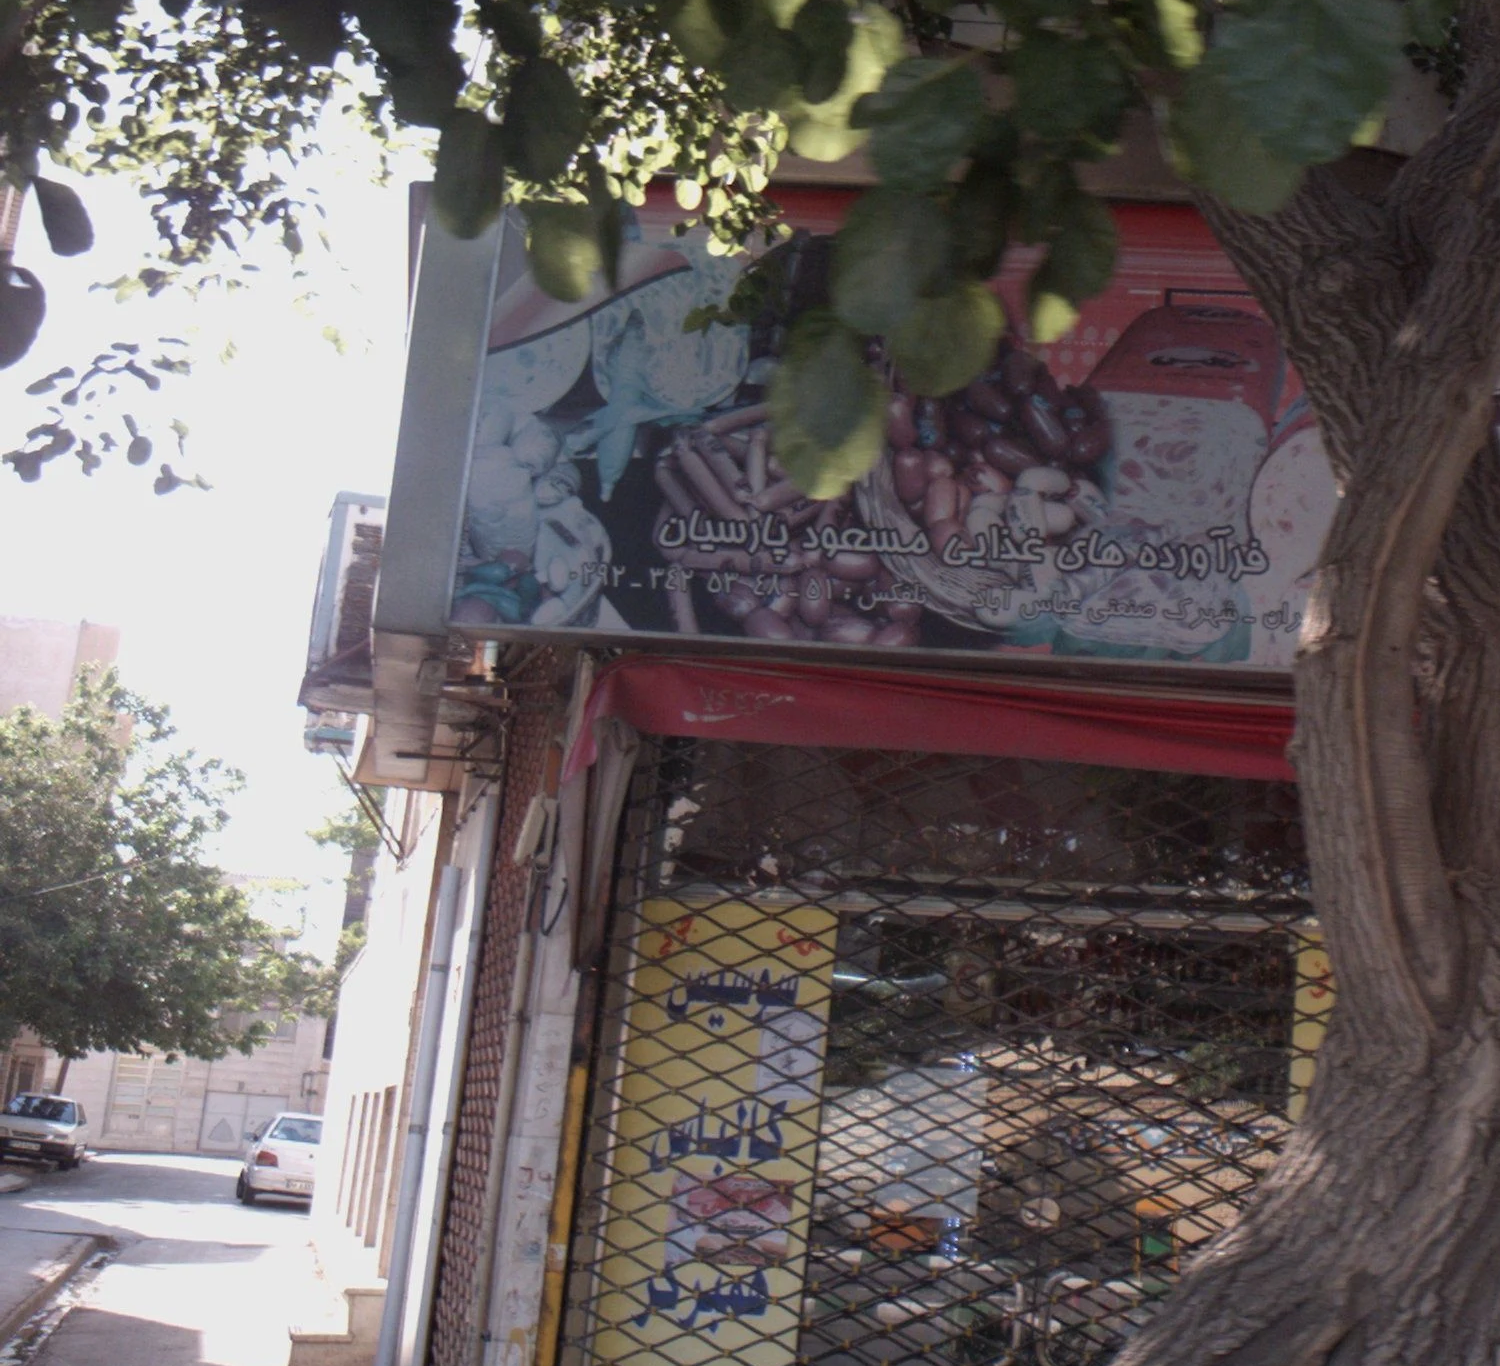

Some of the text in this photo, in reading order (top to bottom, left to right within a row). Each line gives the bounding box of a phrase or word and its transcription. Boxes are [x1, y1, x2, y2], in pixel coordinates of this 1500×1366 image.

[658, 509, 1268, 581] فرآورده های غذایی مسعود پارسیان
[1019, 592, 1082, 620] عباس
[1087, 598, 1156, 624] صنعتی
